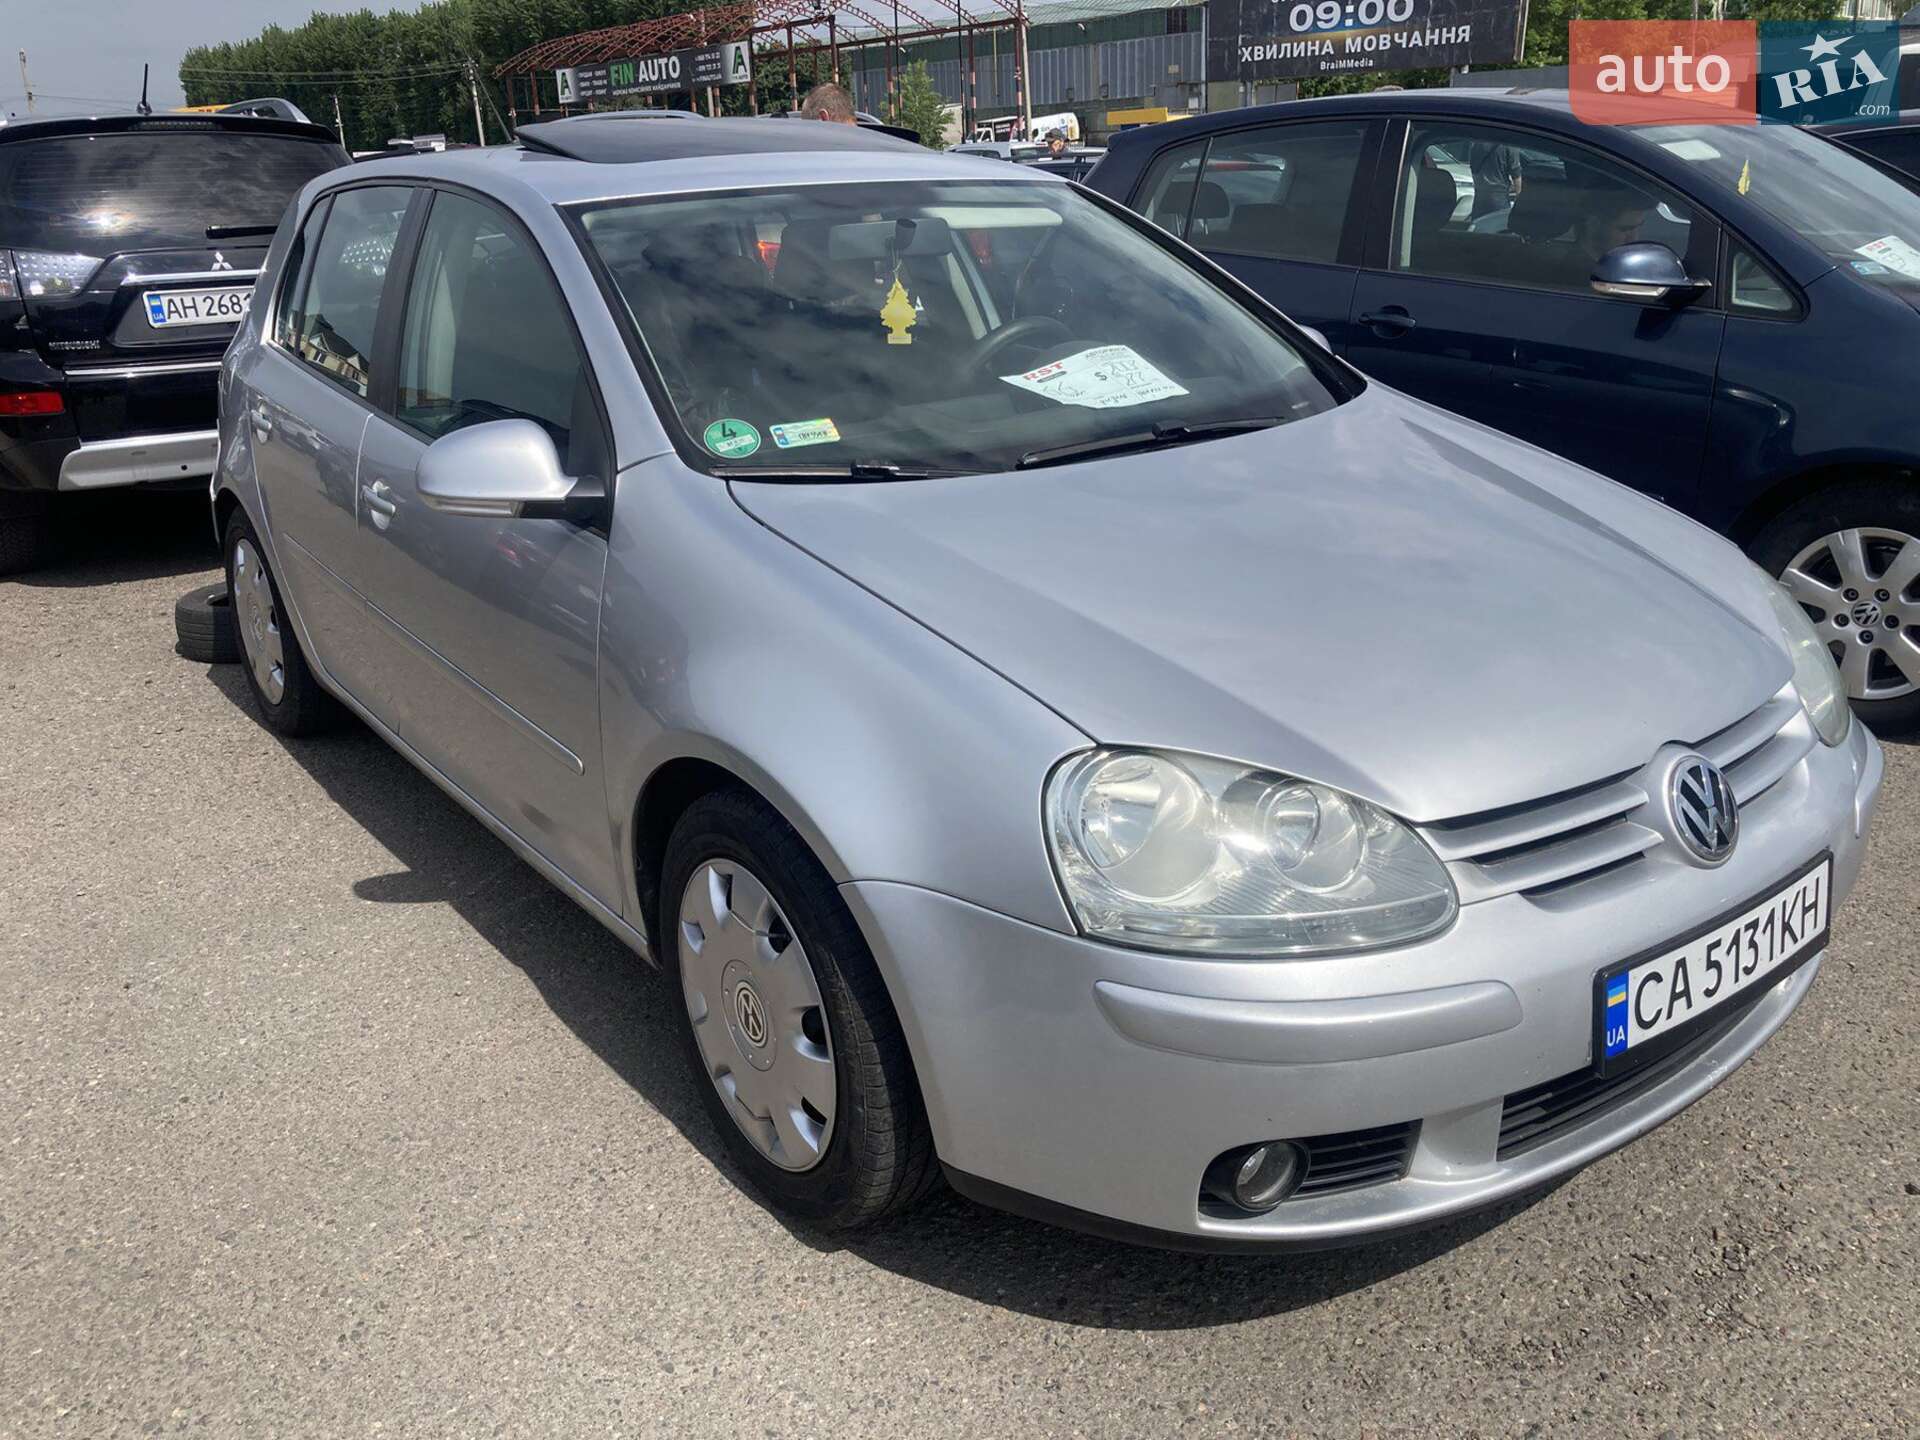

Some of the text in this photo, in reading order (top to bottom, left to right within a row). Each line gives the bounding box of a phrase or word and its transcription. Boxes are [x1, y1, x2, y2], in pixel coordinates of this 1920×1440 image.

[1289, 0, 1414, 32] 09:00
[1241, 25, 1471, 62] ХВИЛИНА МОВЧАННЯ
[610, 63, 635, 86] FIN
[638, 55, 681, 83] AUTO
[153, 313, 165, 321] UA
[167, 293, 251, 319] AH 268
[1023, 362, 1064, 381] RST
[720, 422, 737, 438] 4
[1634, 956, 1693, 1030] CA
[1607, 1025, 1626, 1047] UA
